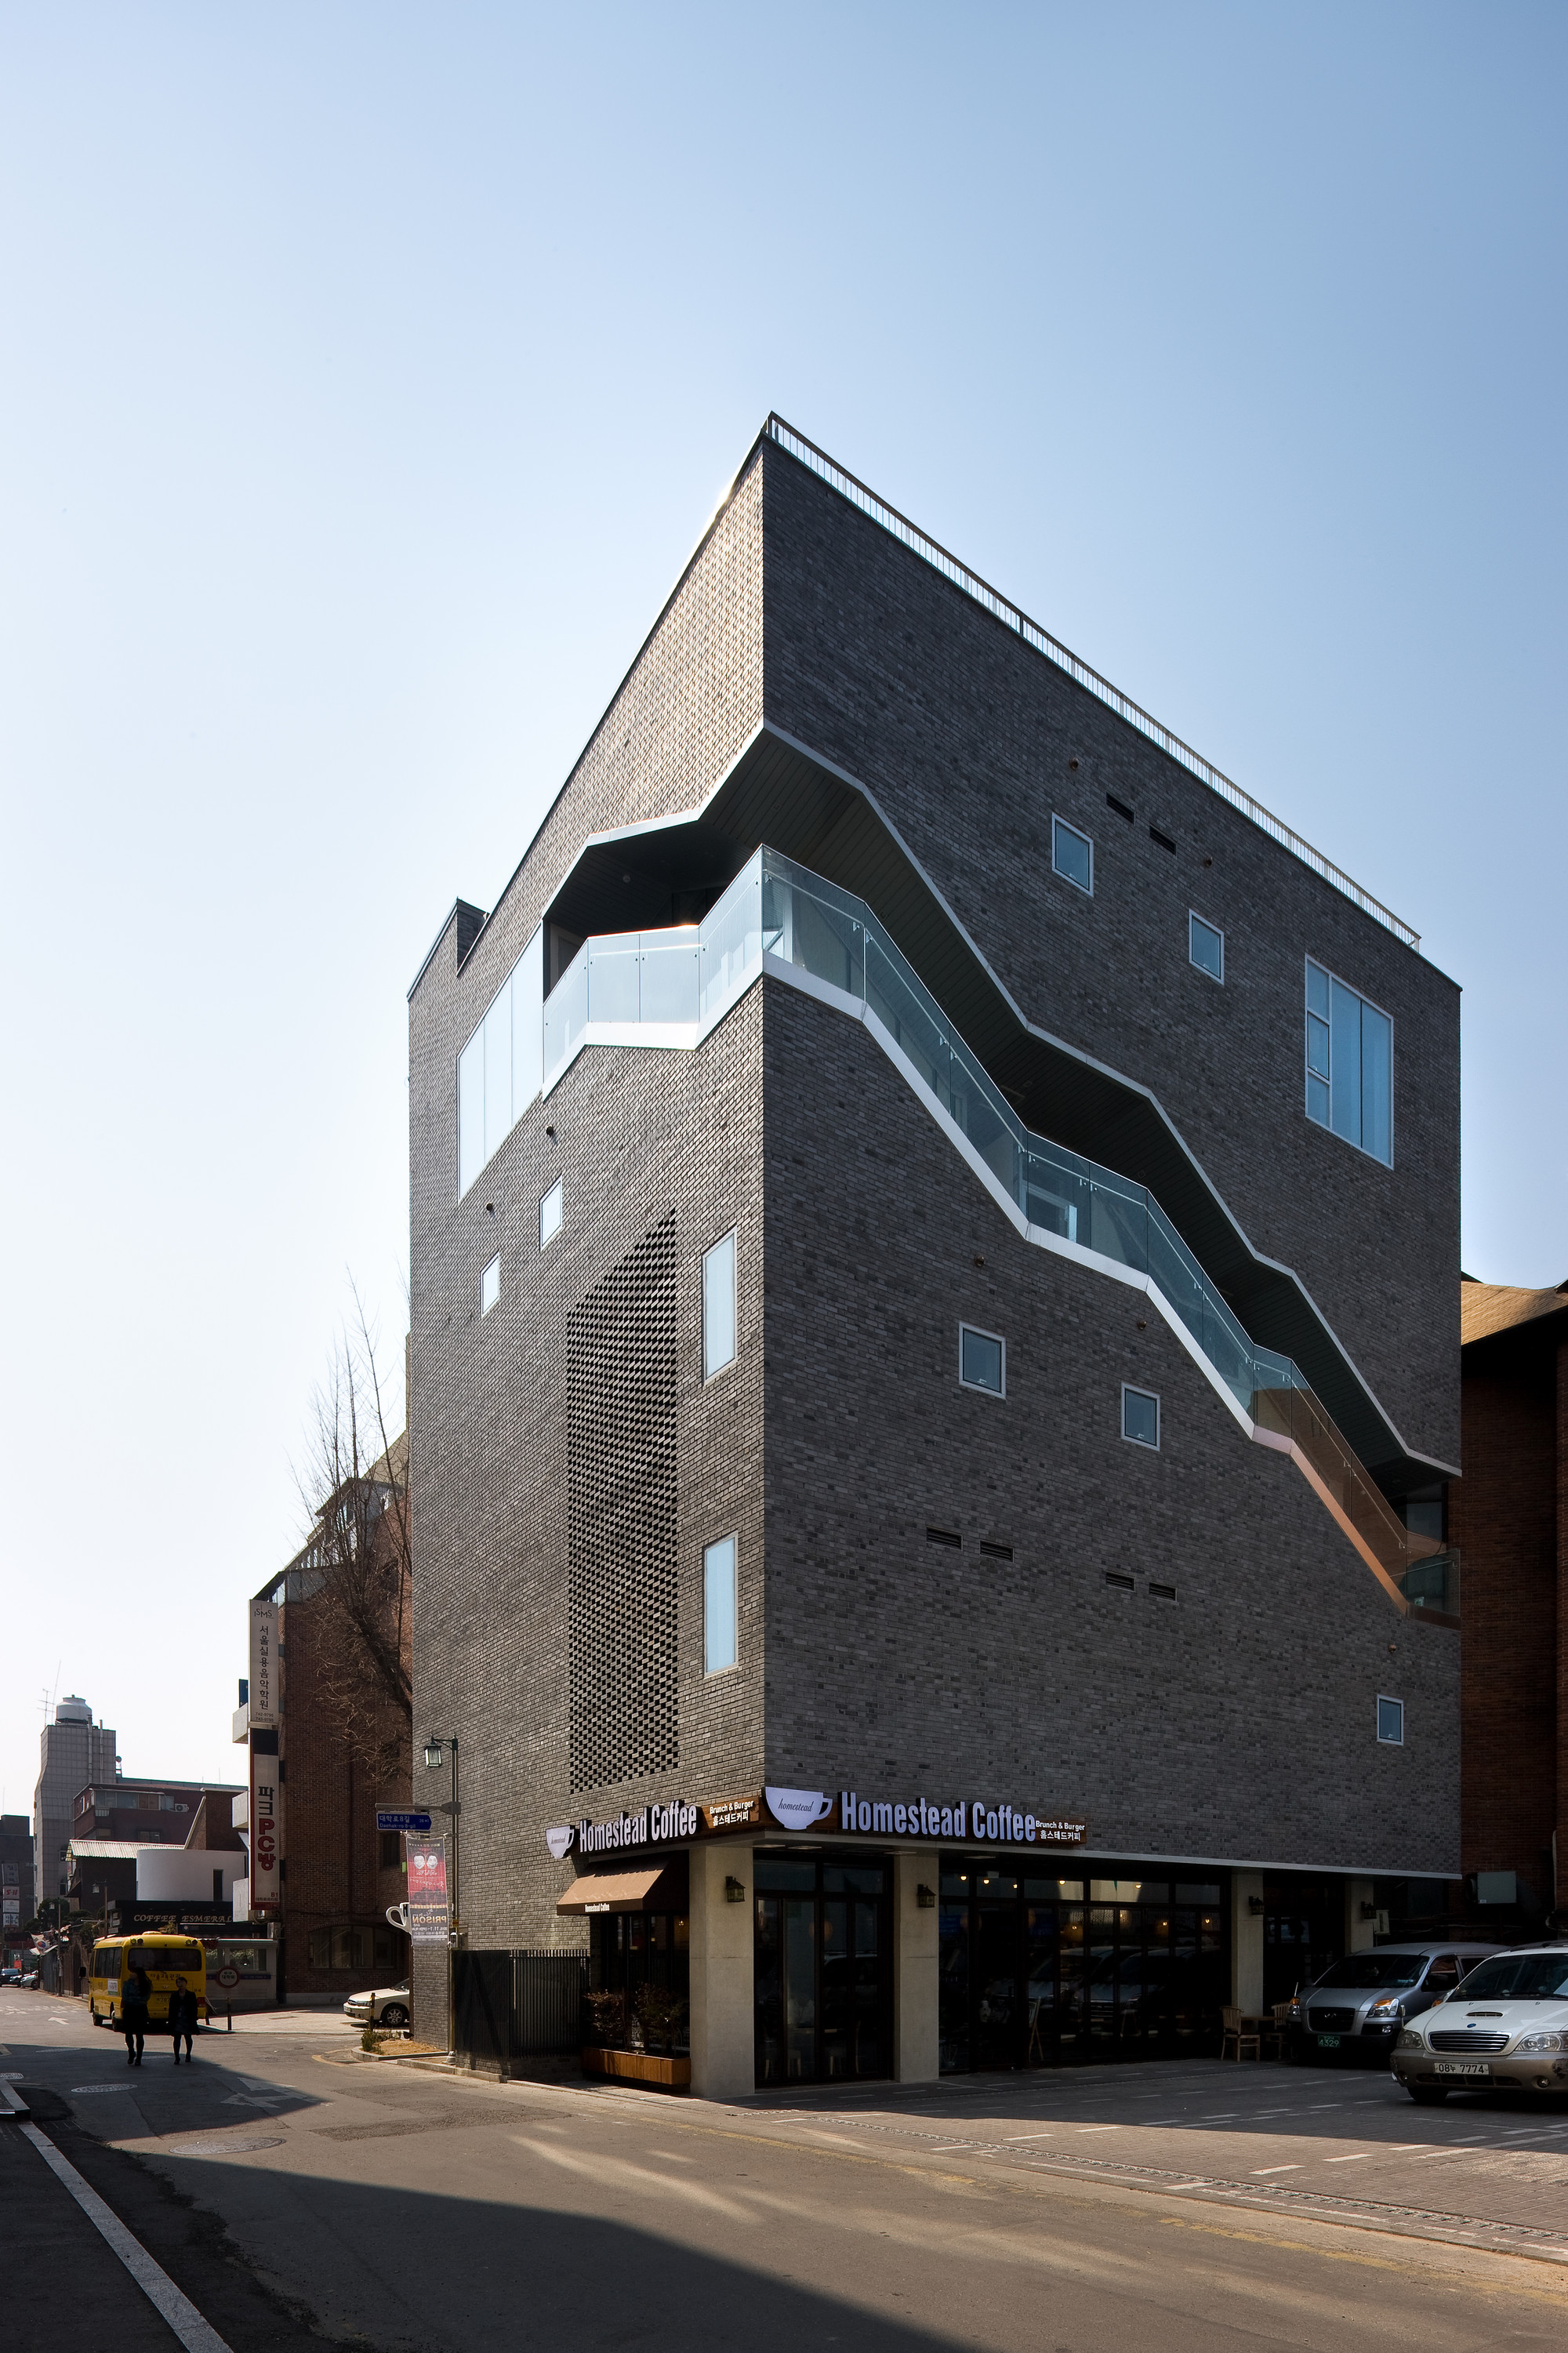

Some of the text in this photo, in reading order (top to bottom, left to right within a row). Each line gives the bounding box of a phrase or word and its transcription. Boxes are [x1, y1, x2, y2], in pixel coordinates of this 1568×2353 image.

[260, 1625, 269, 1710] 서울실용음악학원
[710, 1800, 754, 1814] Brunch & Burger
[379, 1815, 410, 1824] 대학로8길
[712, 1810, 750, 1826] 홈스테드커피
[779, 1791, 1036, 1842] homestead Homestead Coffee
[579, 1807, 648, 1853] Homestead
[651, 1799, 697, 1841] Coffee
[1036, 1820, 1057, 1829] Brunch
[1064, 1822, 1086, 1832] Burger
[1040, 1830, 1081, 1841] 홈스테드커피
[601, 1902, 610, 1912] Coffee
[1319, 2039, 1339, 2047] 4329
[1439, 2064, 1484, 2073] 08누 7774
